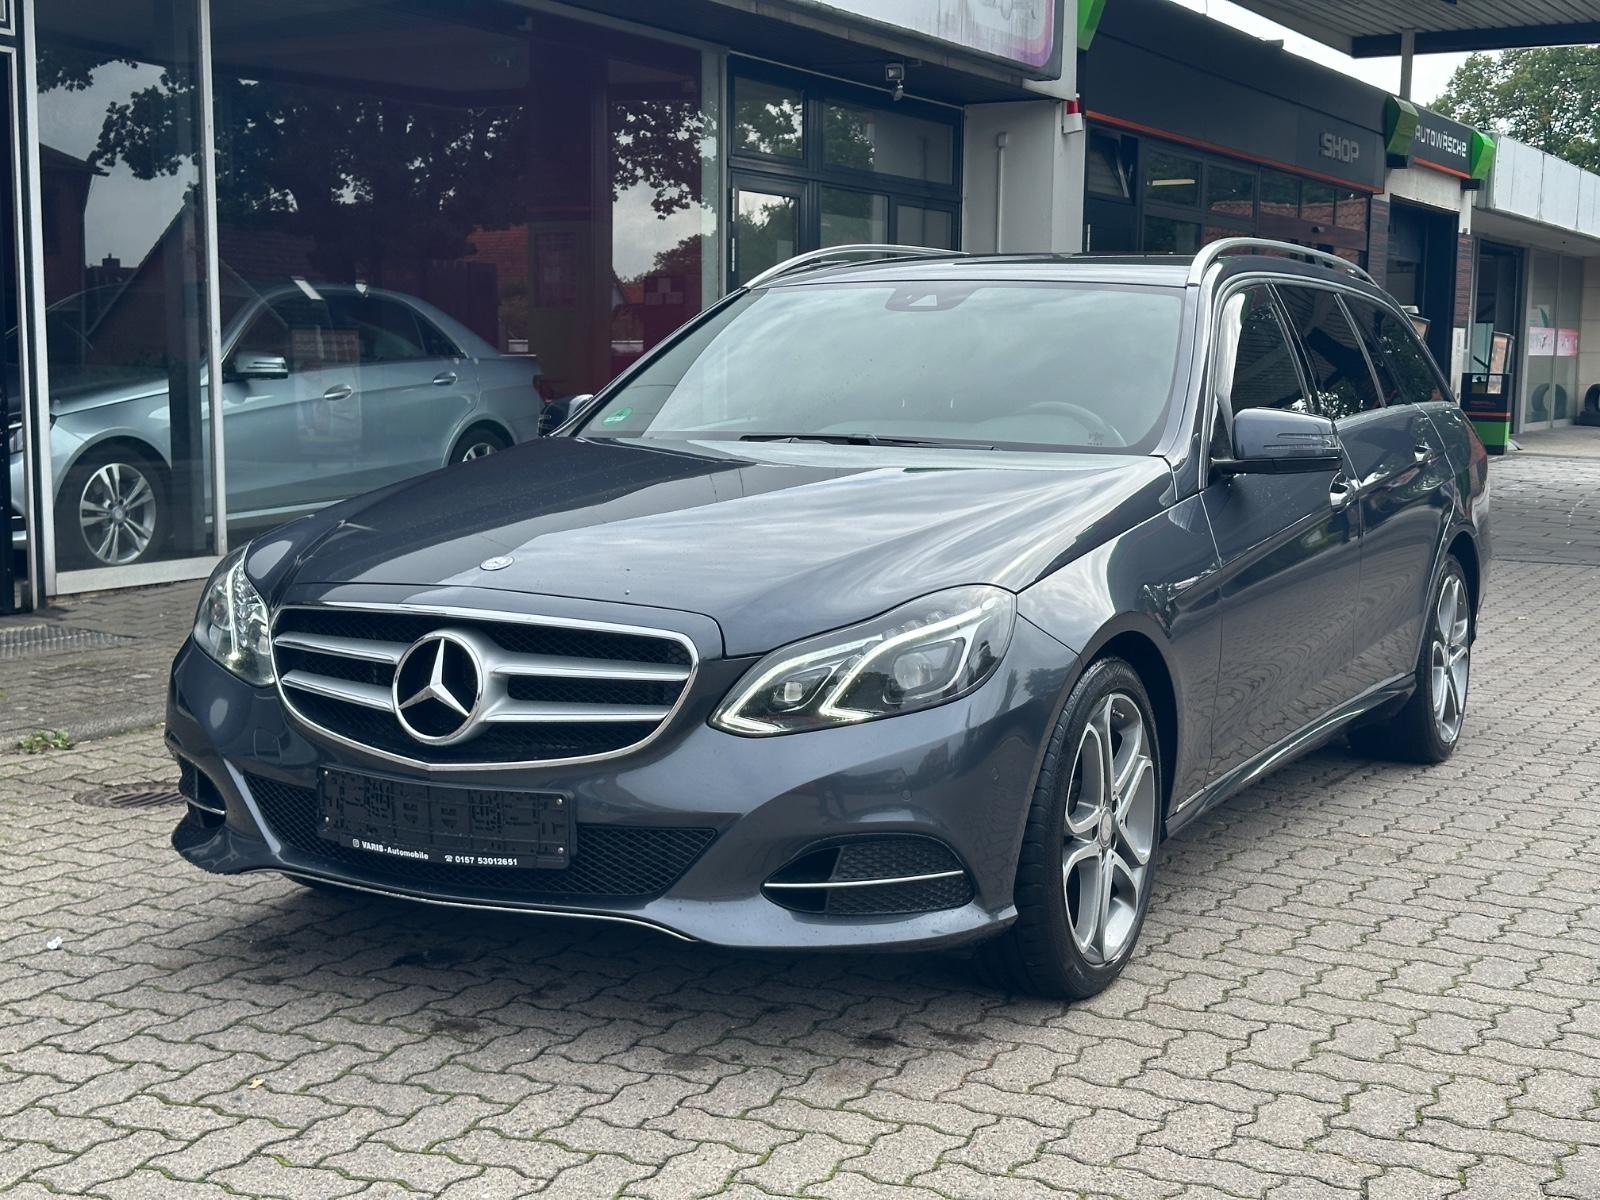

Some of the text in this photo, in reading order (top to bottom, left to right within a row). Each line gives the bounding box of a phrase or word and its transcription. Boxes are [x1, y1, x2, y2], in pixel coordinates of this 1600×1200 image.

[1320, 131, 1359, 163] SHOP
[454, 855, 475, 864] 0157
[477, 856, 518, 866] 53012651
